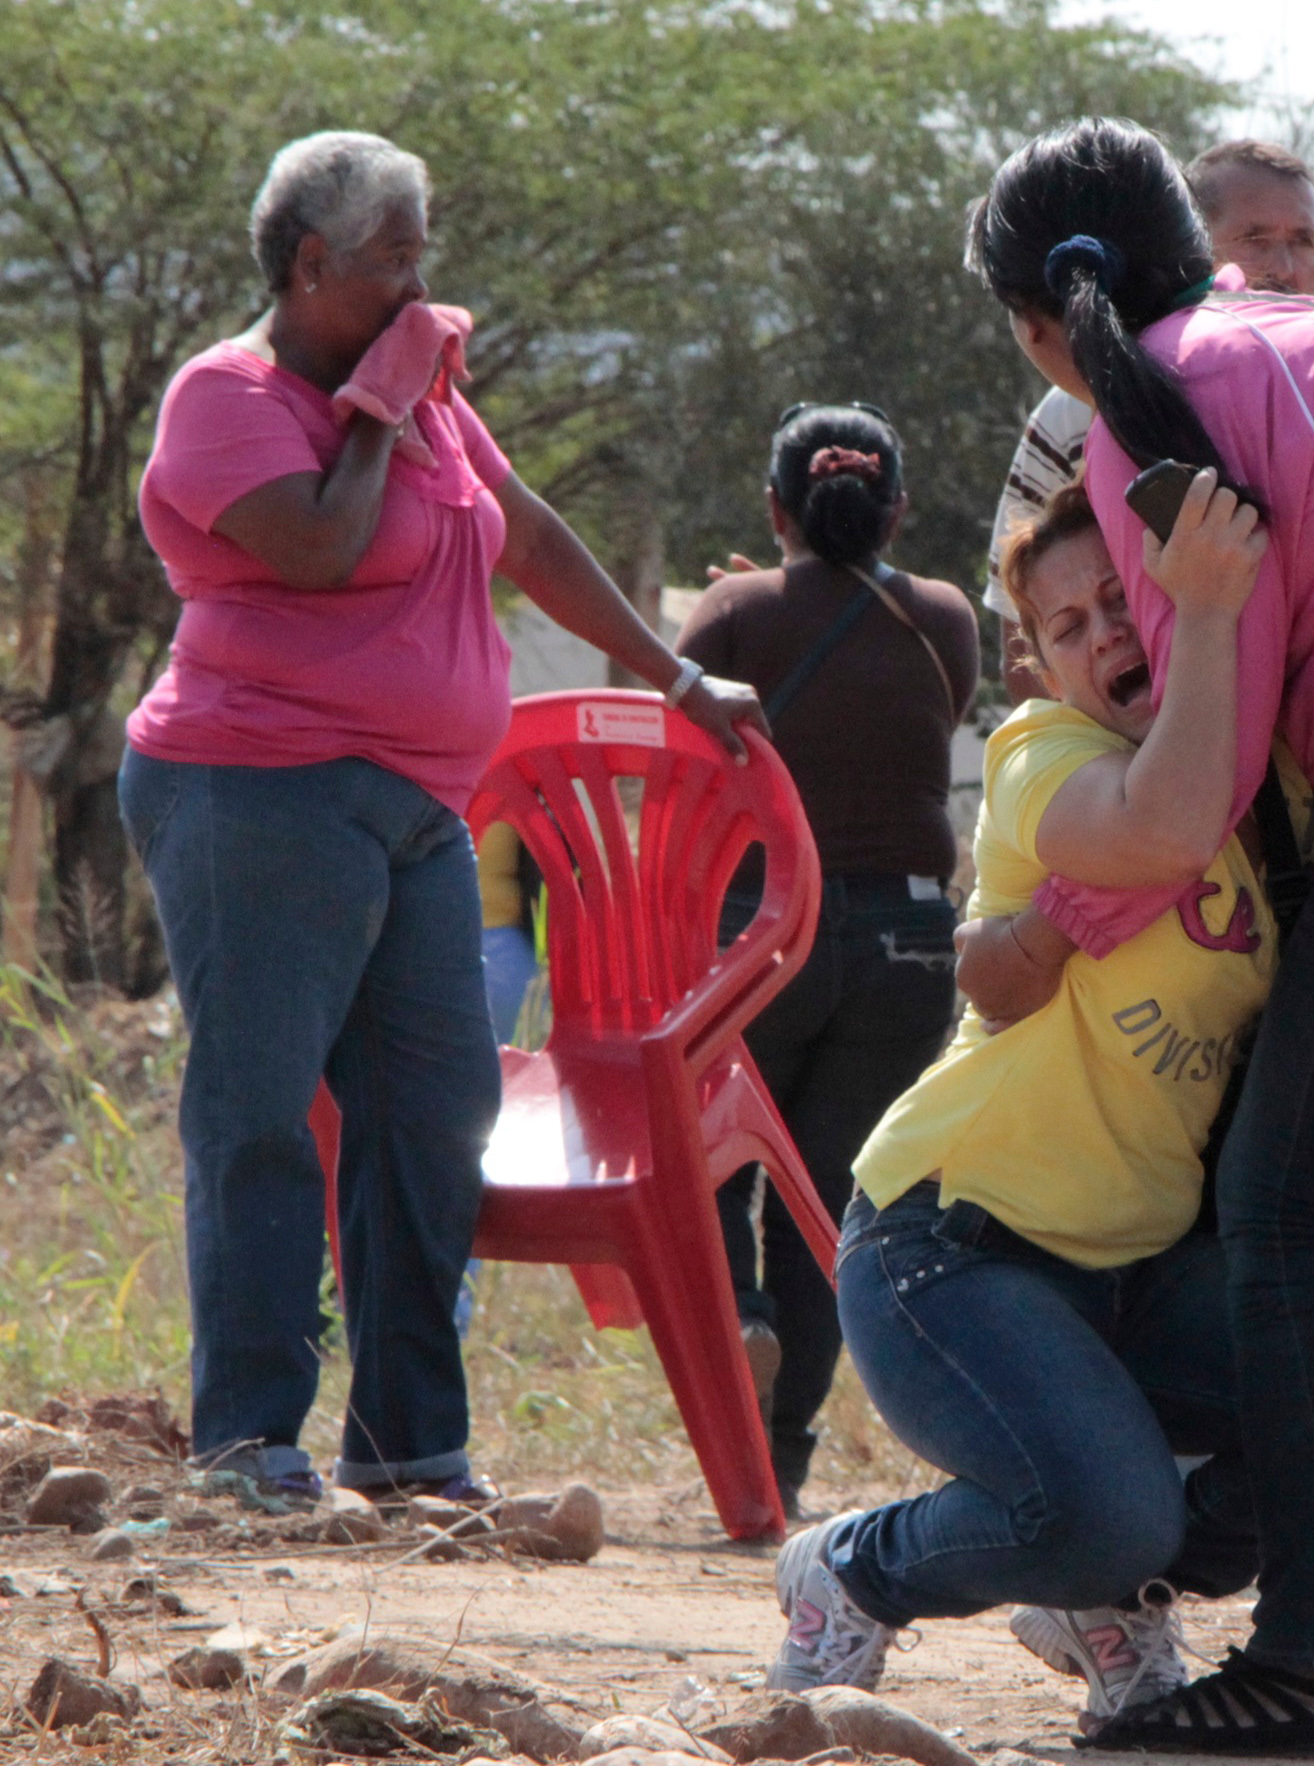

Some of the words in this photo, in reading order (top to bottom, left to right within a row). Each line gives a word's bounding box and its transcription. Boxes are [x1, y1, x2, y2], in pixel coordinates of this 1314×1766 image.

[1111, 997, 1234, 1082] DIVISI
[788, 1596, 825, 1652] N
[1084, 1624, 1138, 1671] N
